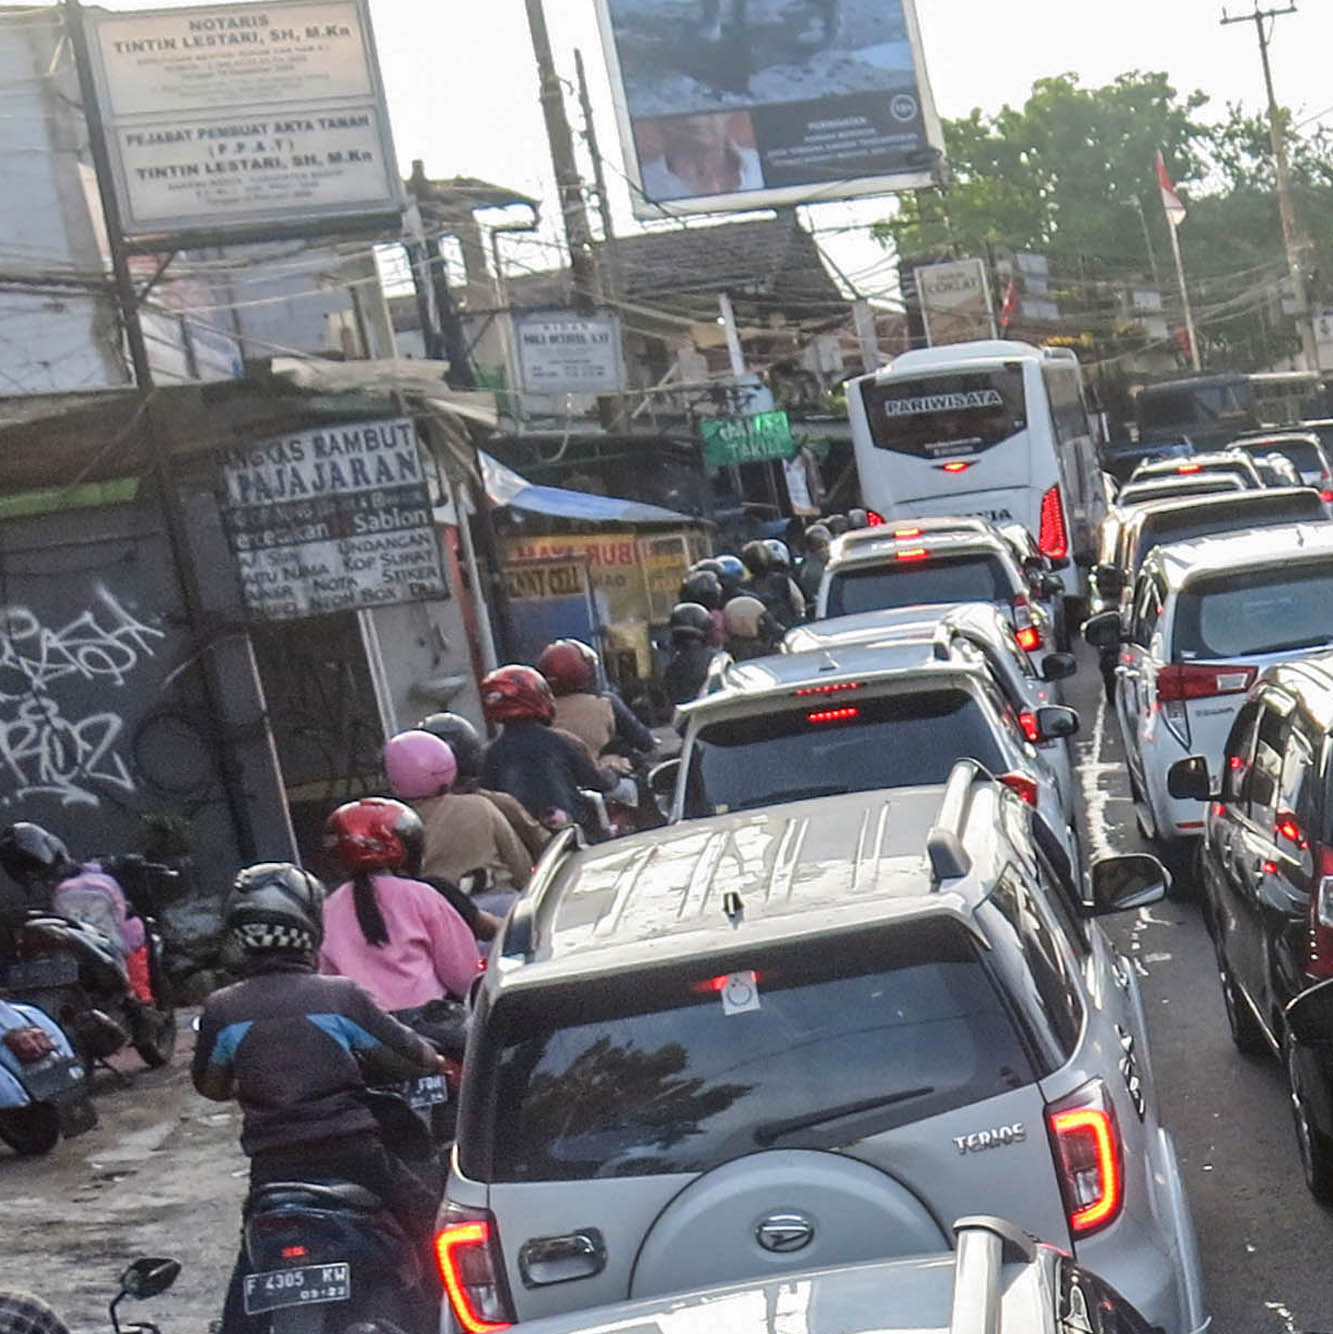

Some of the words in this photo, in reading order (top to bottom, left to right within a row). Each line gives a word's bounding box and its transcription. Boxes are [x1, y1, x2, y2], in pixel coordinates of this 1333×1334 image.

[189, 14, 269, 31] NOTARIS
[114, 39, 176, 53] TINTIN
[126, 131, 193, 147] PEJABAT
[197, 123, 268, 139] PEMBUAT
[274, 119, 314, 133] AKTA
[317, 114, 369, 129] TANAH
[137, 163, 199, 181] TINTIN
[885, 391, 1002, 416] PARIWISATA
[313, 424, 411, 458] RAMBUT
[238, 451, 418, 502] PAJAJARAN
[353, 509, 428, 533] Sablon
[953, 1123, 1026, 1153] TERIOS
[247, 1279, 256, 1295] F
[323, 1267, 346, 1282] KW
